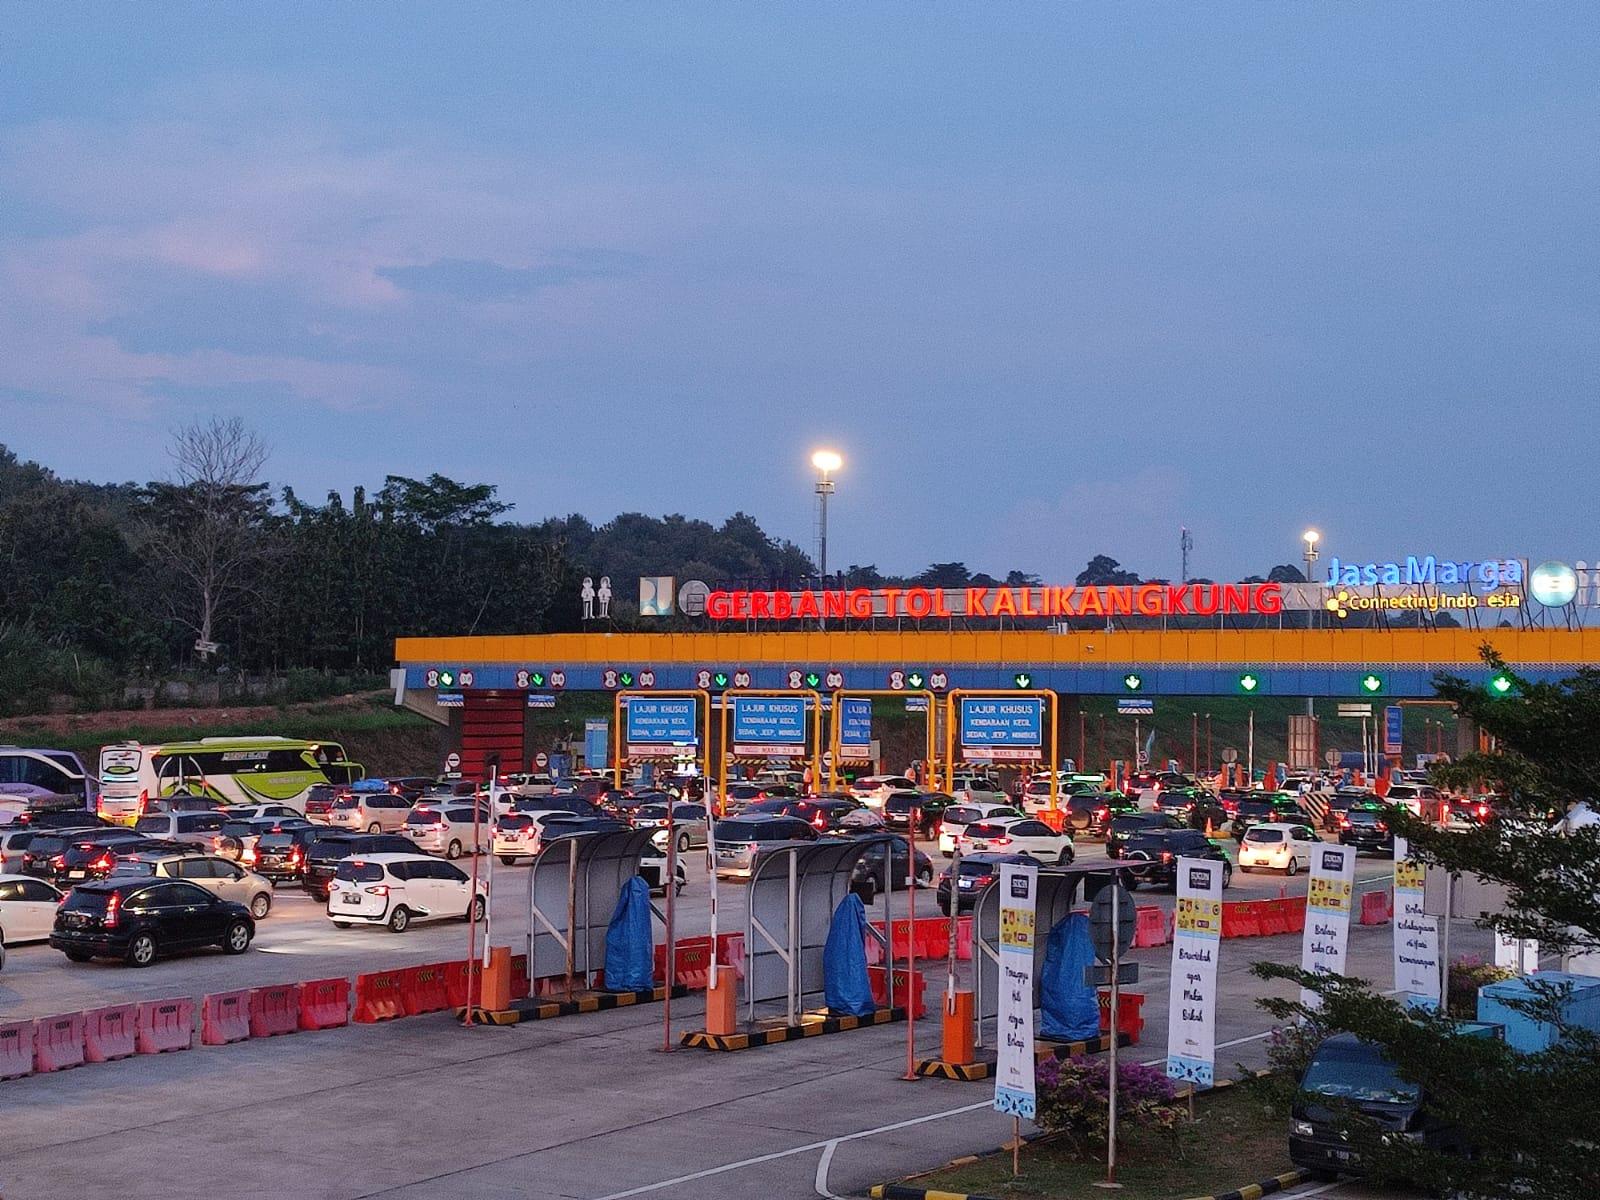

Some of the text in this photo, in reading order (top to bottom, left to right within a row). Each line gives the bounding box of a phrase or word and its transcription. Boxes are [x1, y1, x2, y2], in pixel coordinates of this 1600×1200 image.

[706, 583, 1282, 619] GERBANG TOL KALIKANGKUNG
[1349, 592, 1521, 611] Connecting Indoesia
[634, 705, 689, 714] LAJUR KHUSUS
[741, 704, 798, 713] LAJUR KHUSUS
[969, 705, 1033, 714] LAJUR KHUSUS
